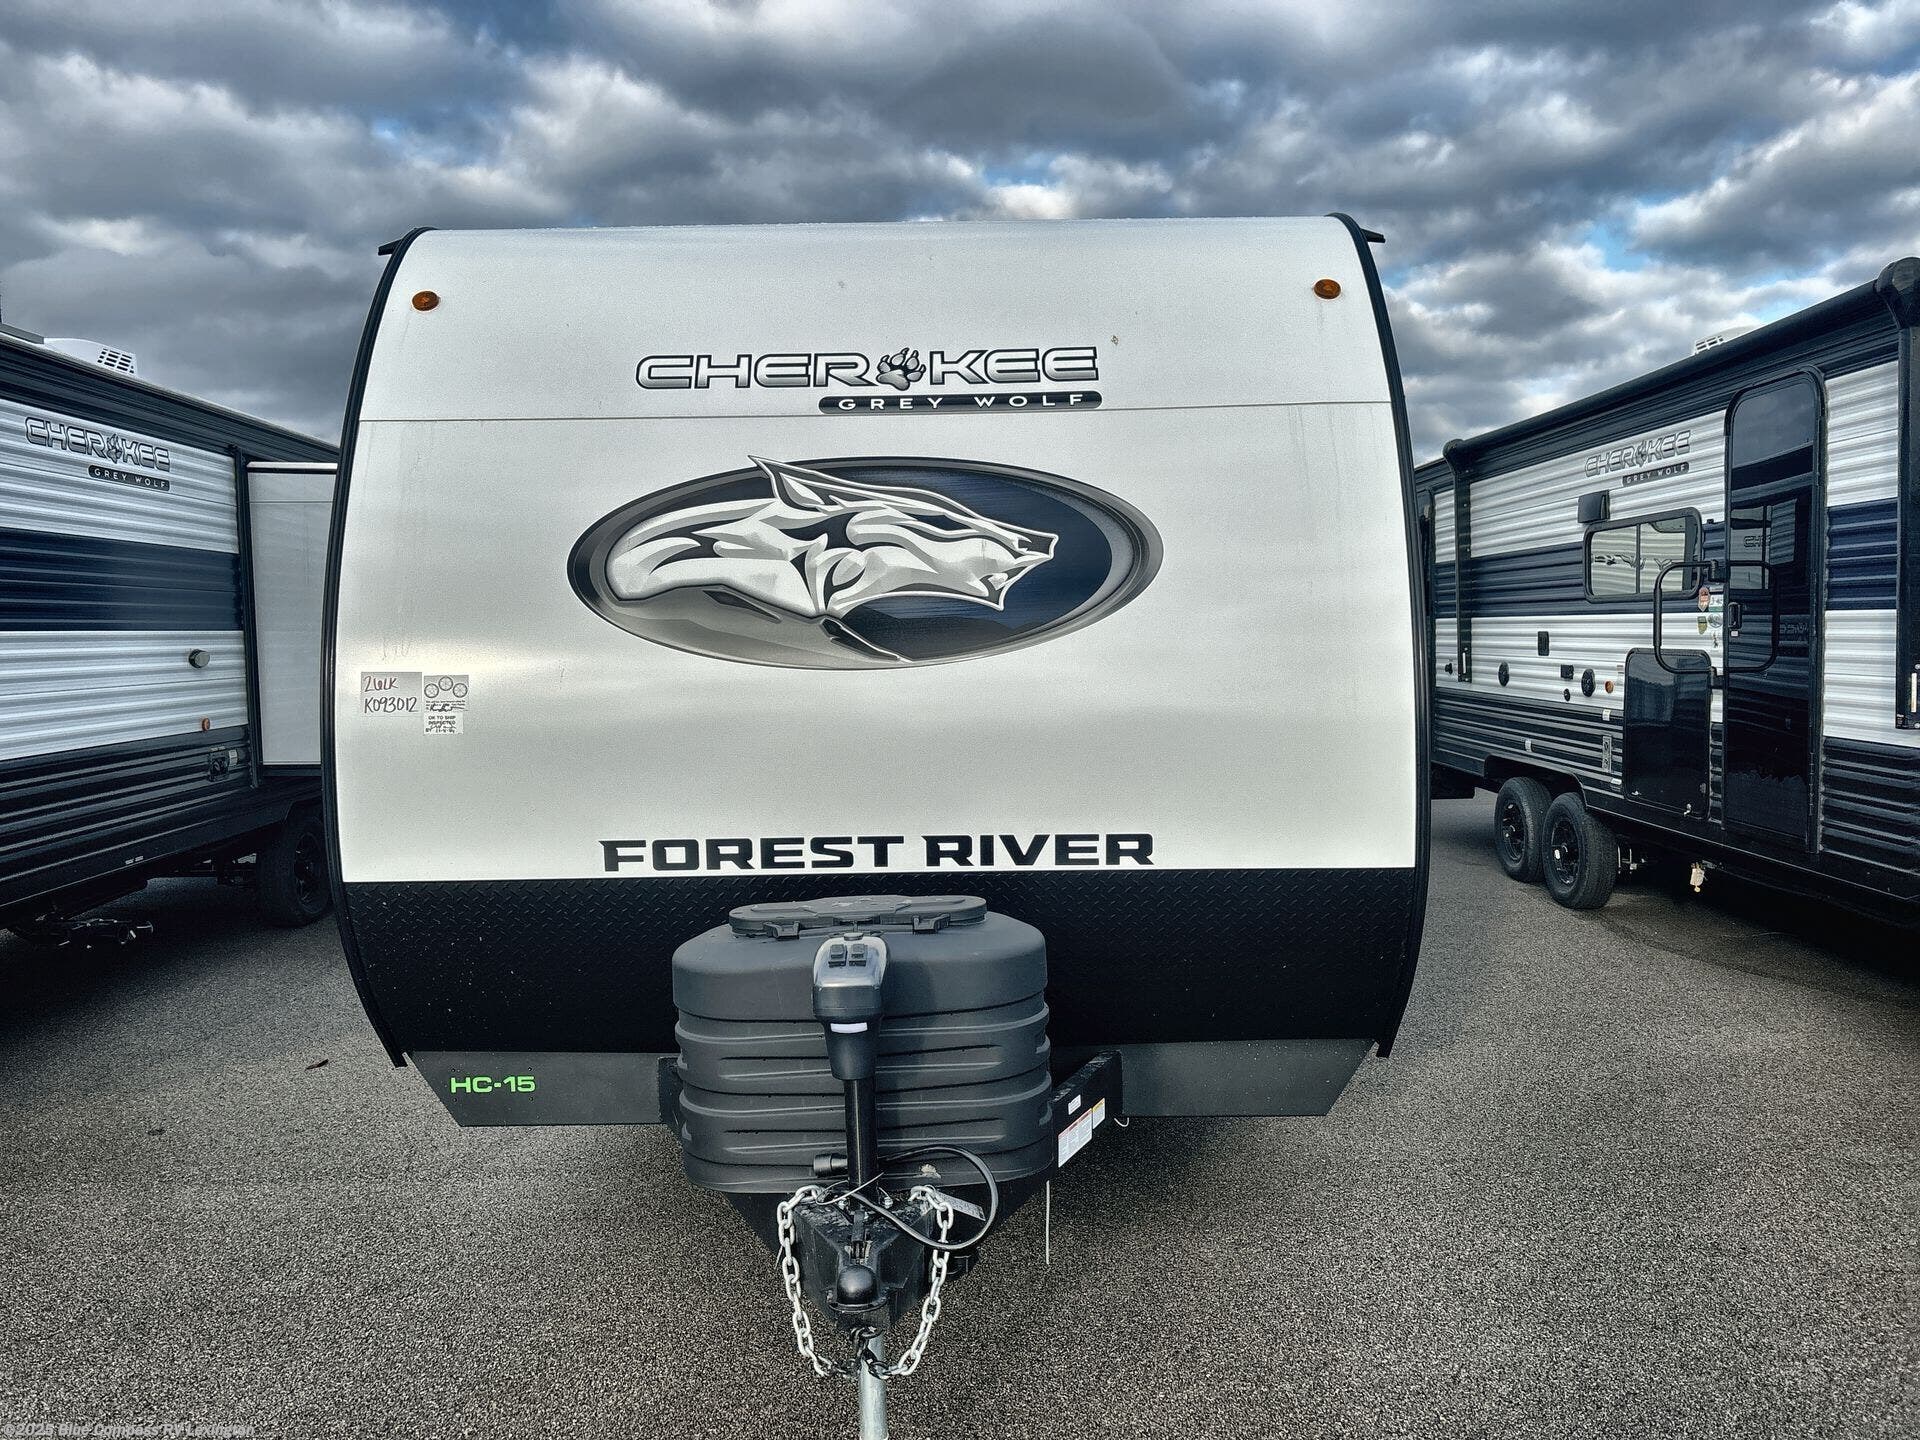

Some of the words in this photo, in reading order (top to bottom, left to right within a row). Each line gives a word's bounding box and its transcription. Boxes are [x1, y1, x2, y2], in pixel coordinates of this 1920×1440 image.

[838, 397, 944, 410] GREY
[974, 393, 1084, 408] WOLF
[94, 468, 128, 481] GREY
[135, 476, 167, 489] WOLF
[1626, 472, 1652, 484] GREY
[1656, 463, 1686, 477] WOLF
[364, 697, 418, 713] K093012
[599, 835, 904, 871] FOREST
[921, 833, 1154, 867] RIVER
[450, 1076, 536, 1093] HC-15
